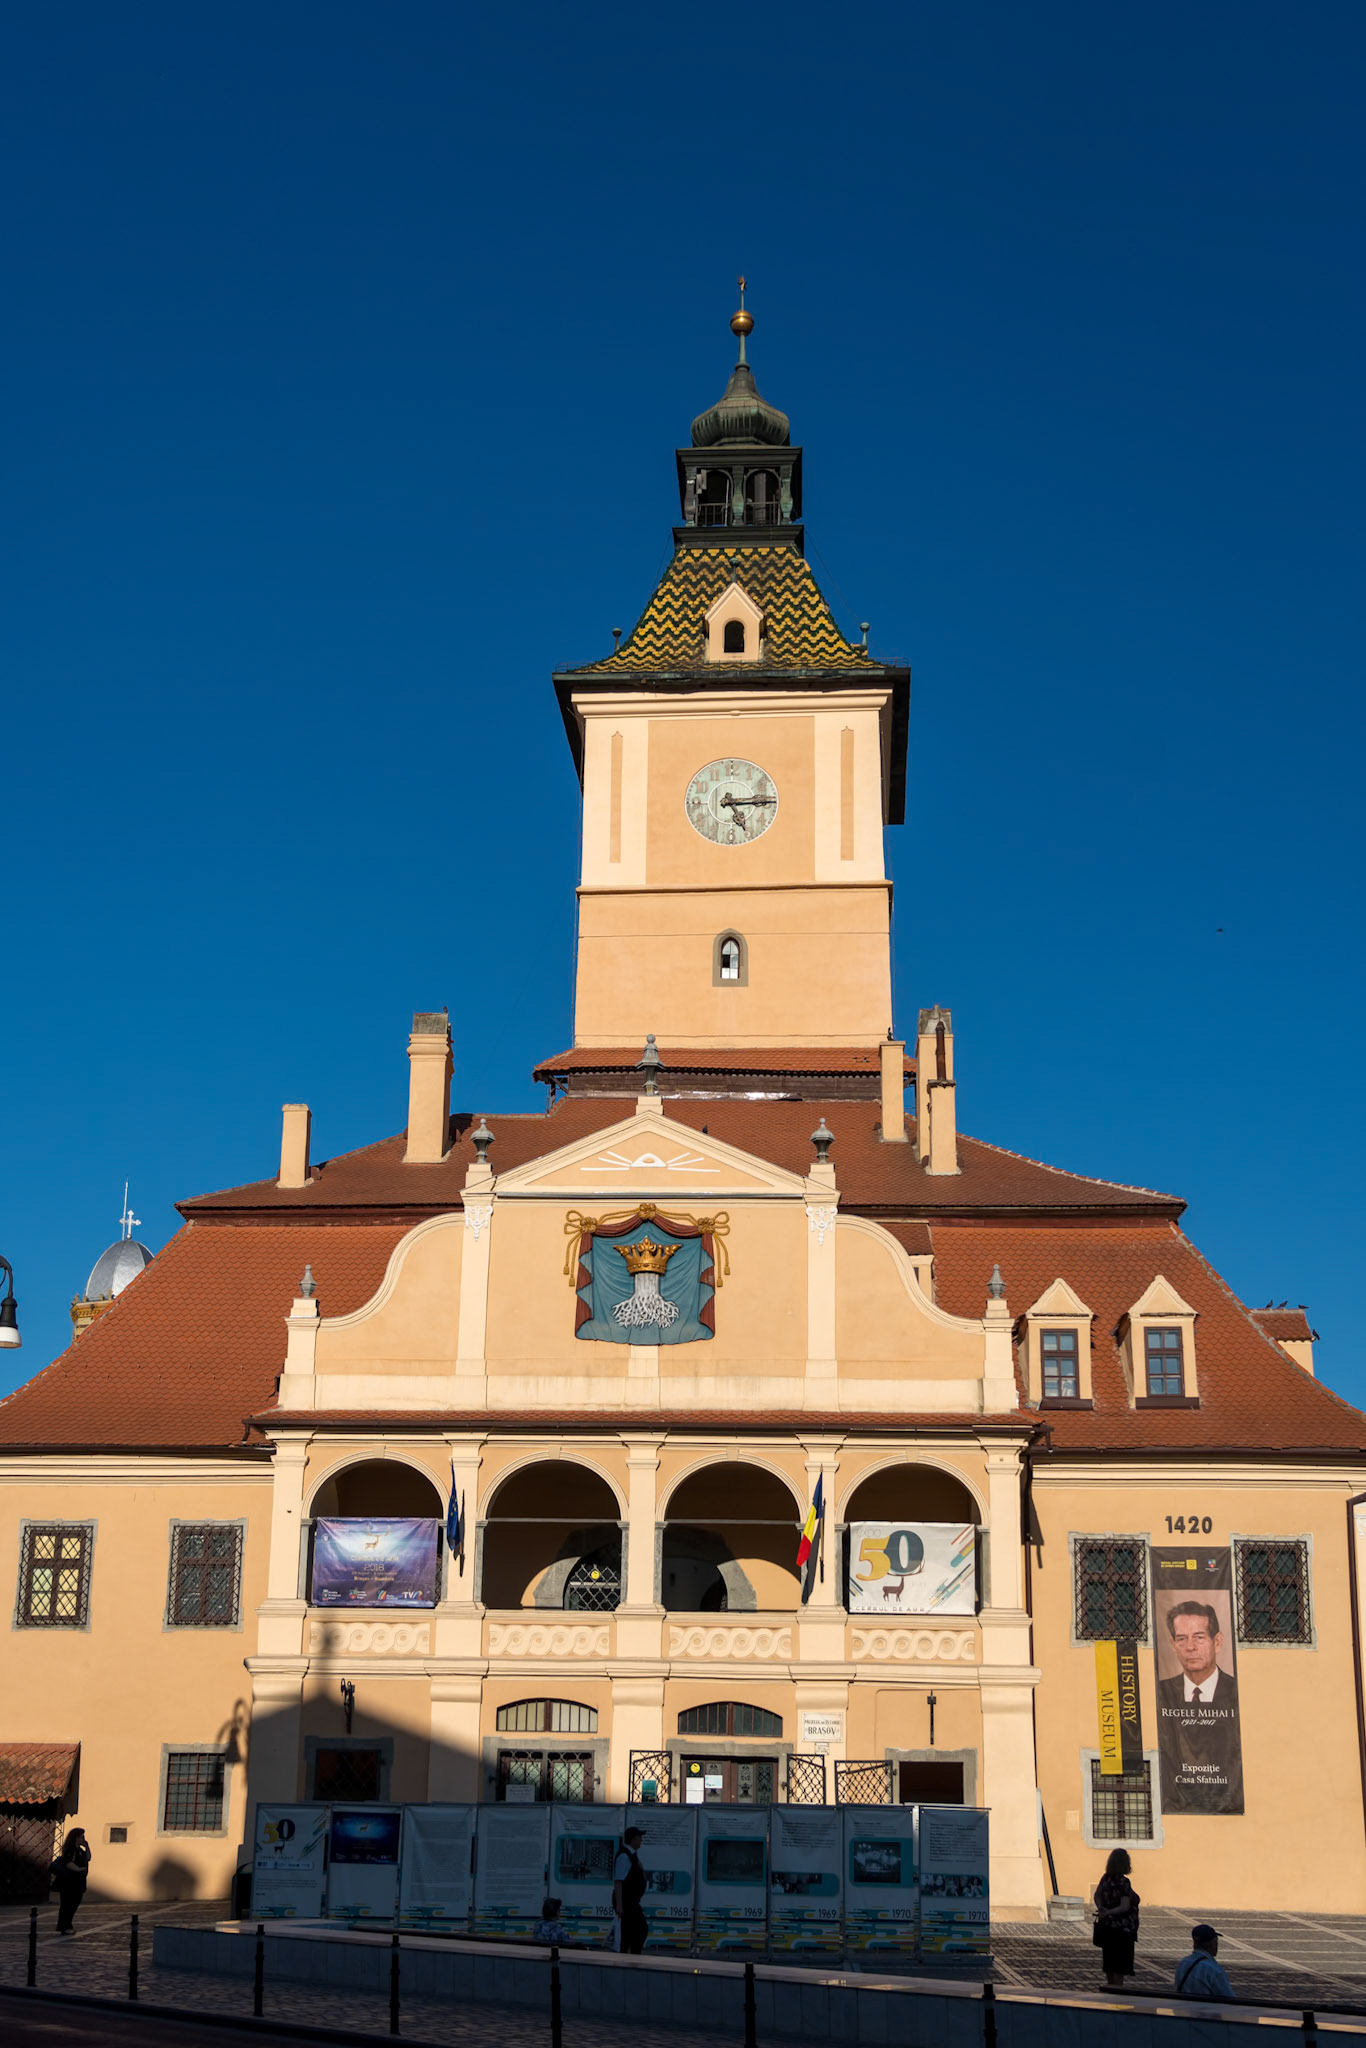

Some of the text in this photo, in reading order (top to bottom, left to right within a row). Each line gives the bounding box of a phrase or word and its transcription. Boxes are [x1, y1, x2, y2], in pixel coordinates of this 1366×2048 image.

[709, 767, 720, 781] 11
[725, 763, 740, 777] 12
[696, 780, 709, 794] 10
[1165, 1515, 1213, 1534] 1420
[856, 1530, 924, 1581] 50
[363, 1563, 385, 1571] 2018
[1120, 1655, 1137, 1723] HISTORY
[1162, 1707, 1195, 1717] REGELE
[1231, 1708, 1235, 1718] I
[1100, 1690, 1117, 1758] MUSEUM
[1175, 1775, 1228, 1784] Casa Sfatului
[262, 1818, 296, 1845] 50
[595, 1906, 614, 1916] 1968
[669, 1906, 688, 1917] 1968
[743, 1906, 763, 1917] 1969
[817, 1908, 837, 1919] 1969
[891, 1908, 911, 1919] 1970
[967, 1910, 988, 1921] 1970
